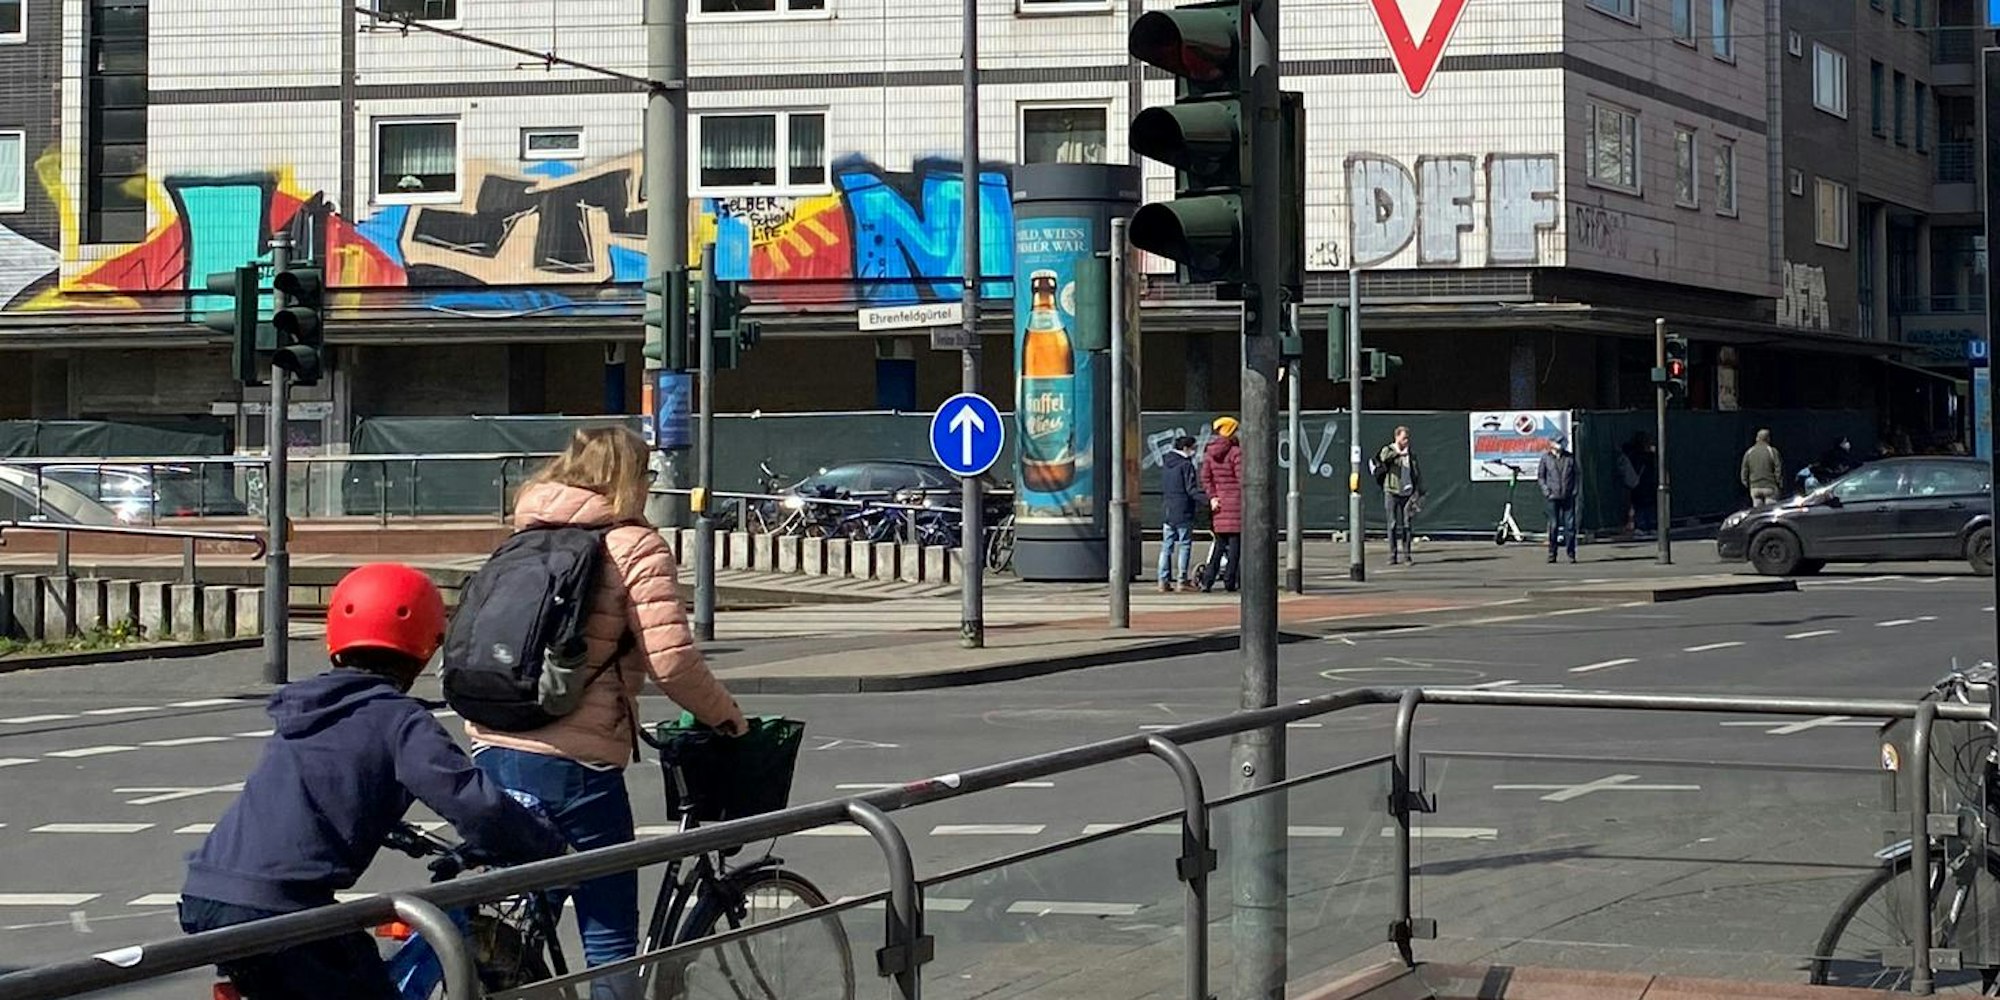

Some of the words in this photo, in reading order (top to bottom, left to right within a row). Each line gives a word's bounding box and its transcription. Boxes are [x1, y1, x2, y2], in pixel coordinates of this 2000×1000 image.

[1344, 153, 1561, 268] DFF
[869, 307, 952, 325] Ehrenfeldgürtel
[1972, 341, 1986, 357] U
